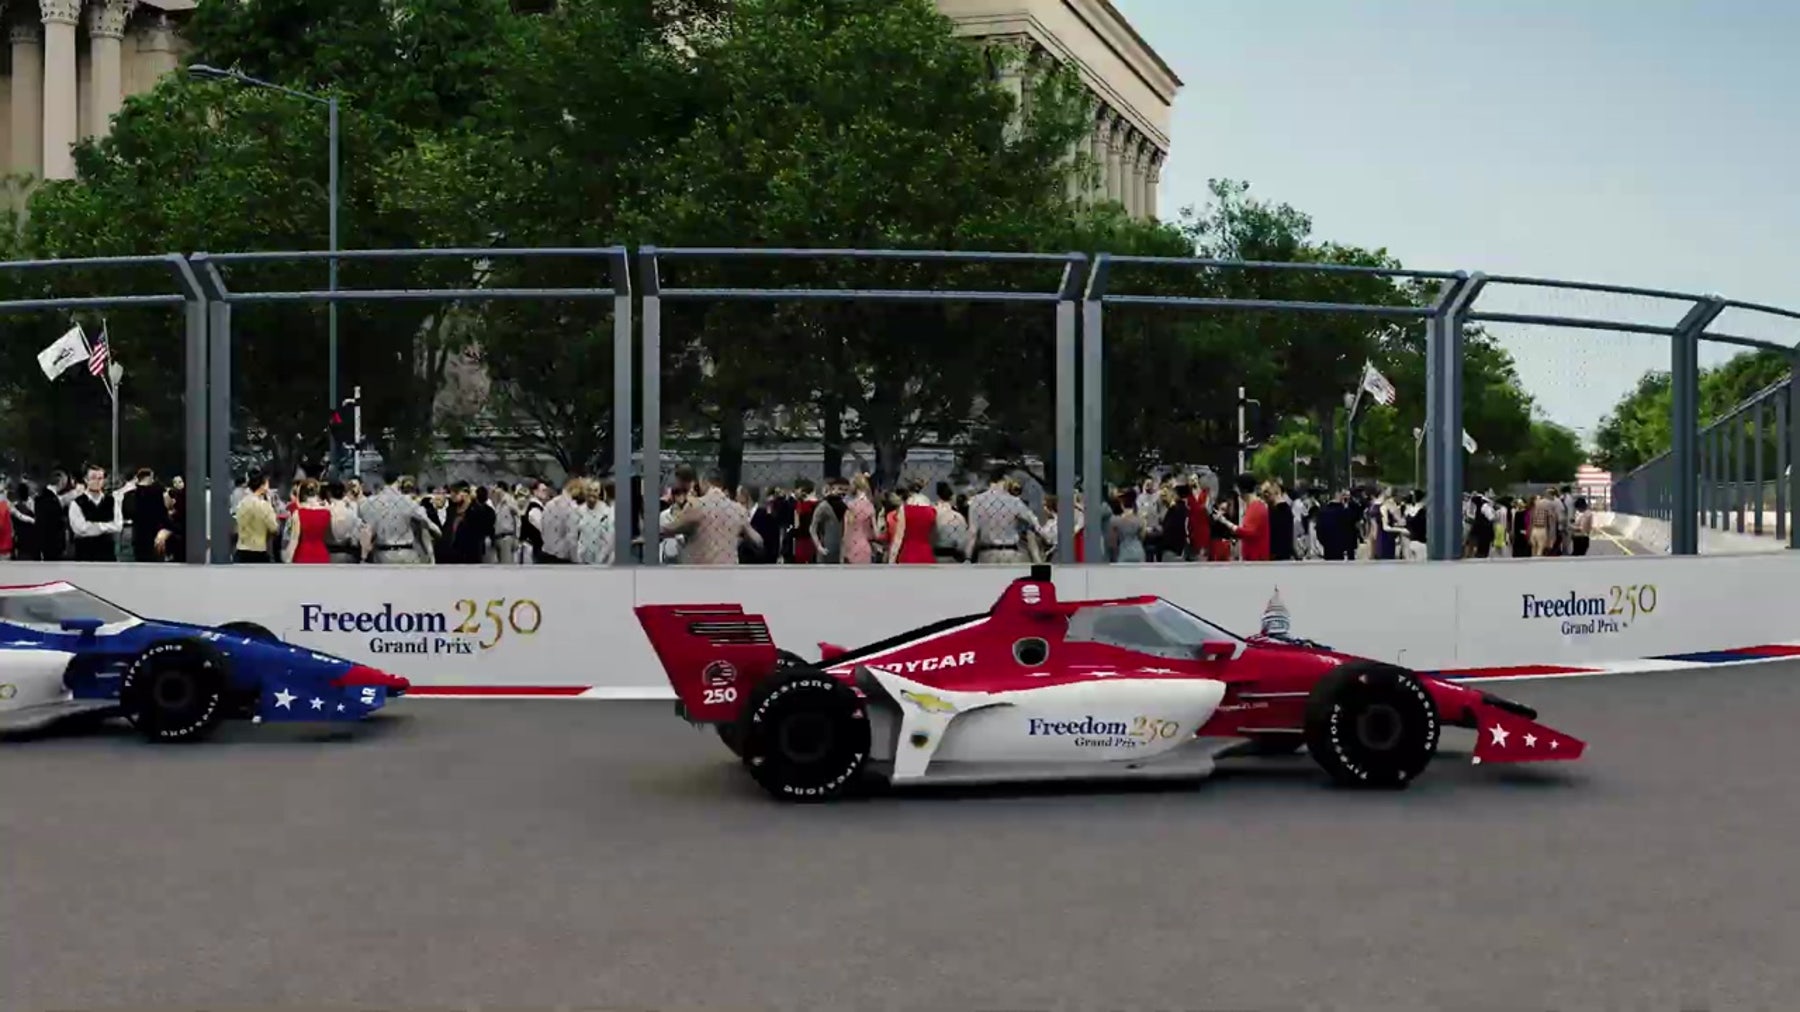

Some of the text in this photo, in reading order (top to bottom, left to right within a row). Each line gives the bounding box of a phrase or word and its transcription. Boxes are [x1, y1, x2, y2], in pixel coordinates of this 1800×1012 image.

[1522, 583, 1657, 623] Freedom 250
[300, 597, 541, 650] Freedom 250
[1561, 619, 1619, 635] Grand Prix
[369, 637, 472, 655] Grand Prix
[702, 687, 738, 705] 250
[1029, 714, 1180, 744] Freedom 250
[1074, 737, 1137, 748] Grand Prix
